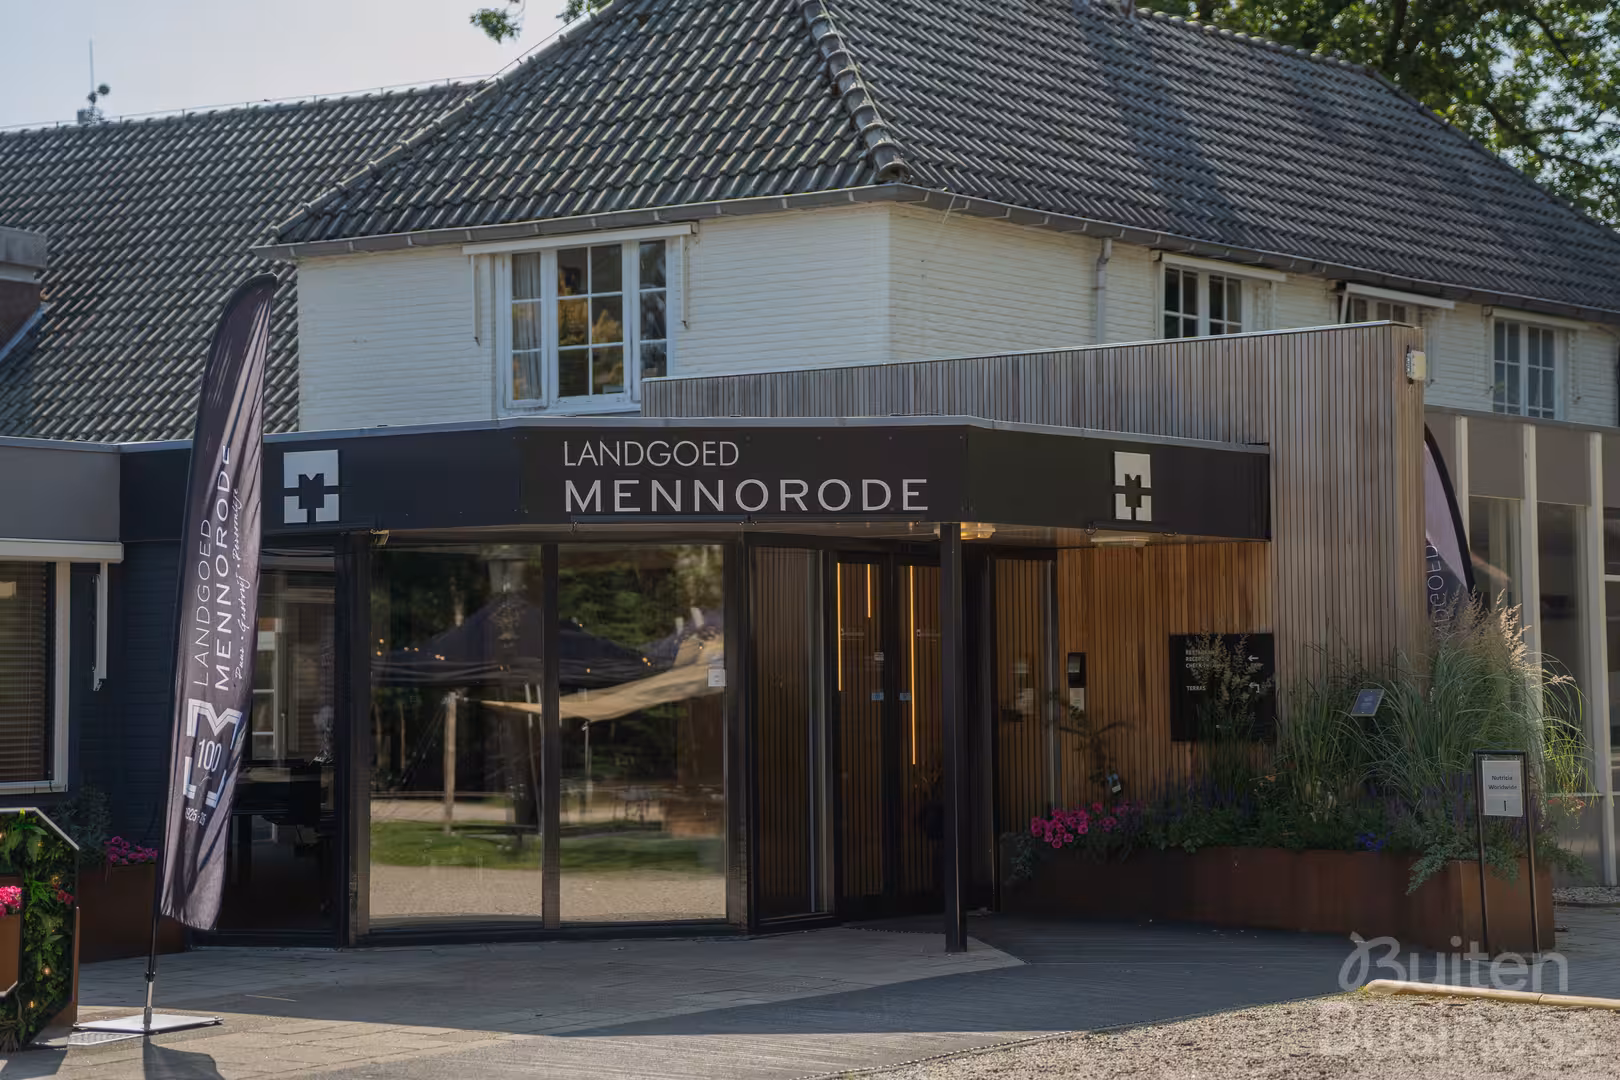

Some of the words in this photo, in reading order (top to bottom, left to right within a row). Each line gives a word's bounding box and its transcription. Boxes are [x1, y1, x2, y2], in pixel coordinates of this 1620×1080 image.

[564, 440, 739, 467] LANDGOED
[565, 479, 929, 512] MENNORODE
[215, 445, 232, 691] MENNORODE
[193, 519, 211, 687] LANDGOED
[197, 738, 222, 773] 100
